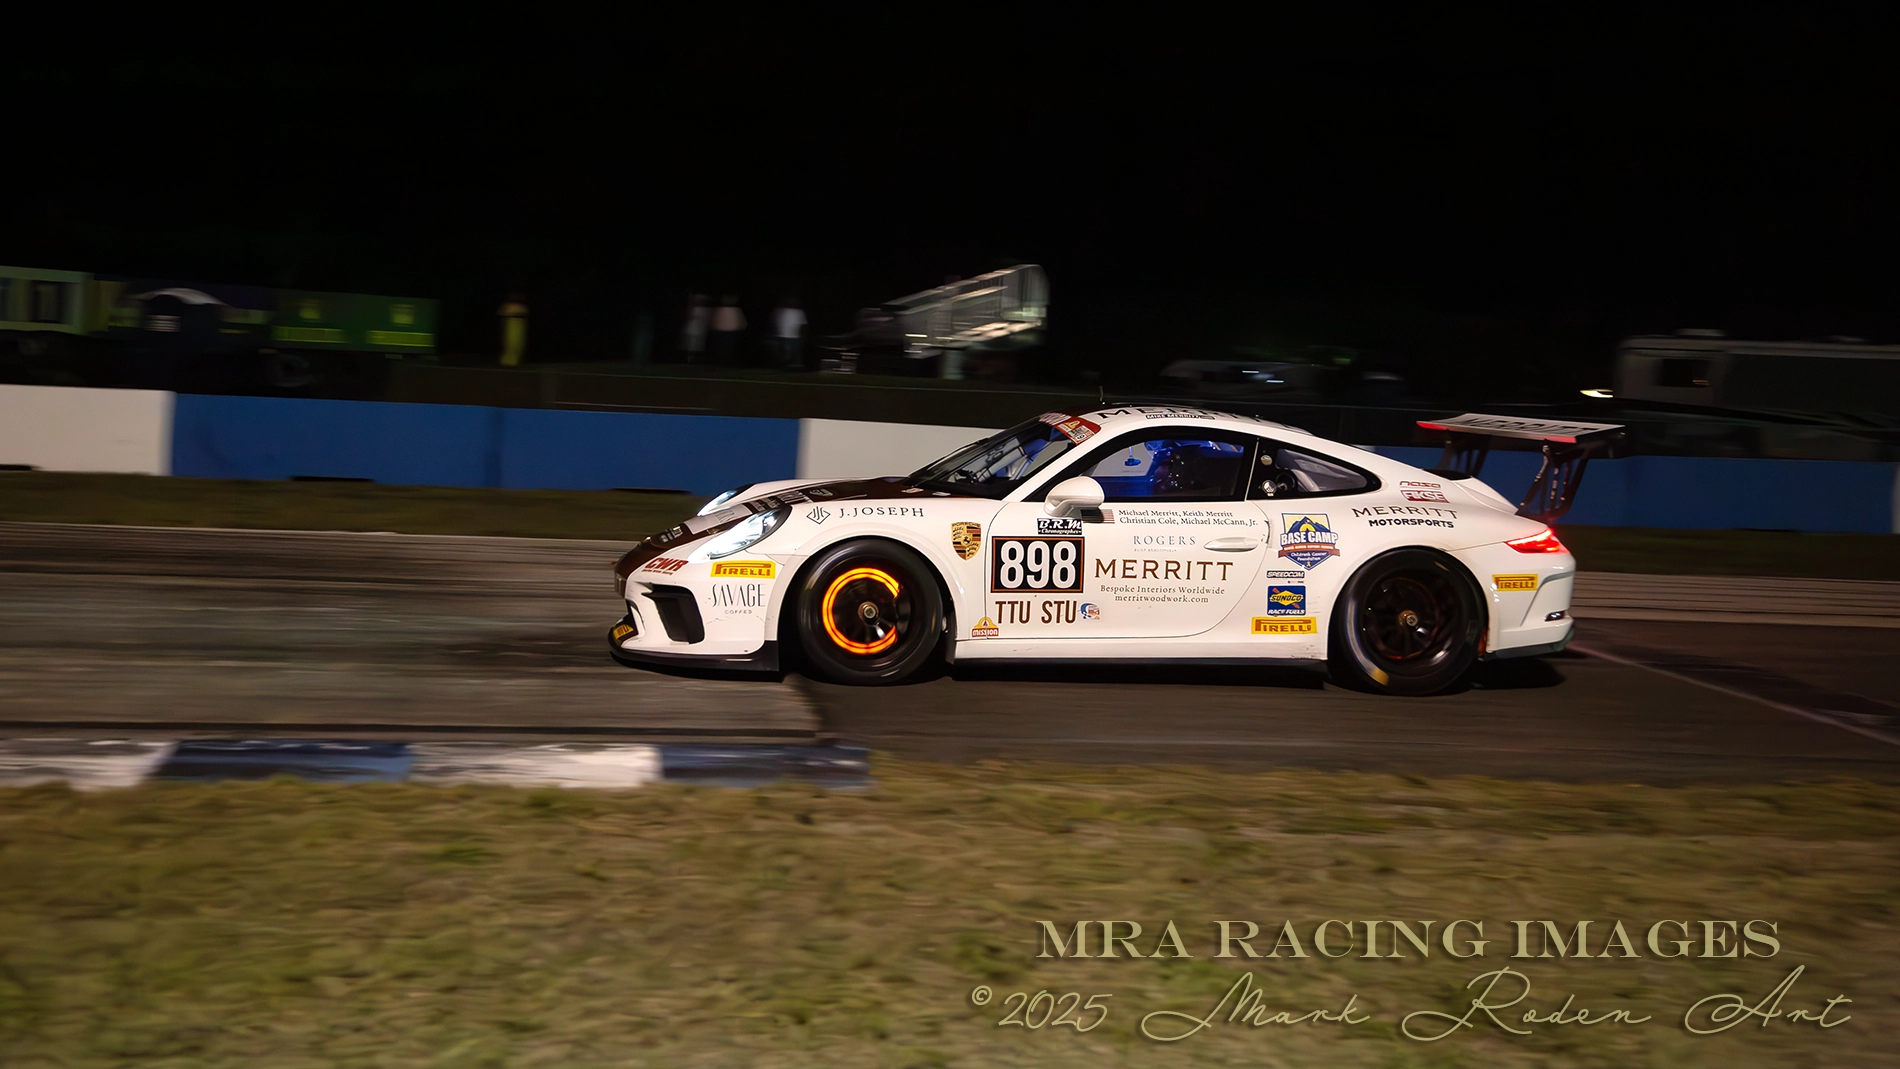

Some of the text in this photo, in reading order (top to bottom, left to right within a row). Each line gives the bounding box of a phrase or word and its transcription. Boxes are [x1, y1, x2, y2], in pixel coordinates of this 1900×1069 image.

[1151, 509, 1181, 517] Merritt,
[1352, 506, 1457, 519] MERRITT
[1158, 517, 1179, 525] Cole,
[1213, 518, 1248, 526] McCann,
[1249, 518, 1258, 527] Jr.
[1369, 518, 1454, 528] MOTORSPORTS
[1133, 535, 1196, 545] ROGERS
[1281, 532, 1337, 545] BASE CAMP
[645, 558, 689, 571] CWR
[715, 563, 772, 576] PIRELLI
[1000, 541, 1076, 588] 898
[1095, 558, 1233, 581] MERRITT
[1494, 576, 1535, 589] PIRELLI
[712, 583, 767, 607] SAVAGE
[1100, 585, 1225, 594] Bespoke Interiors Worldwide
[995, 601, 1031, 624] TTU
[1041, 600, 1077, 624] STU
[1255, 619, 1311, 632] PIRELLI
